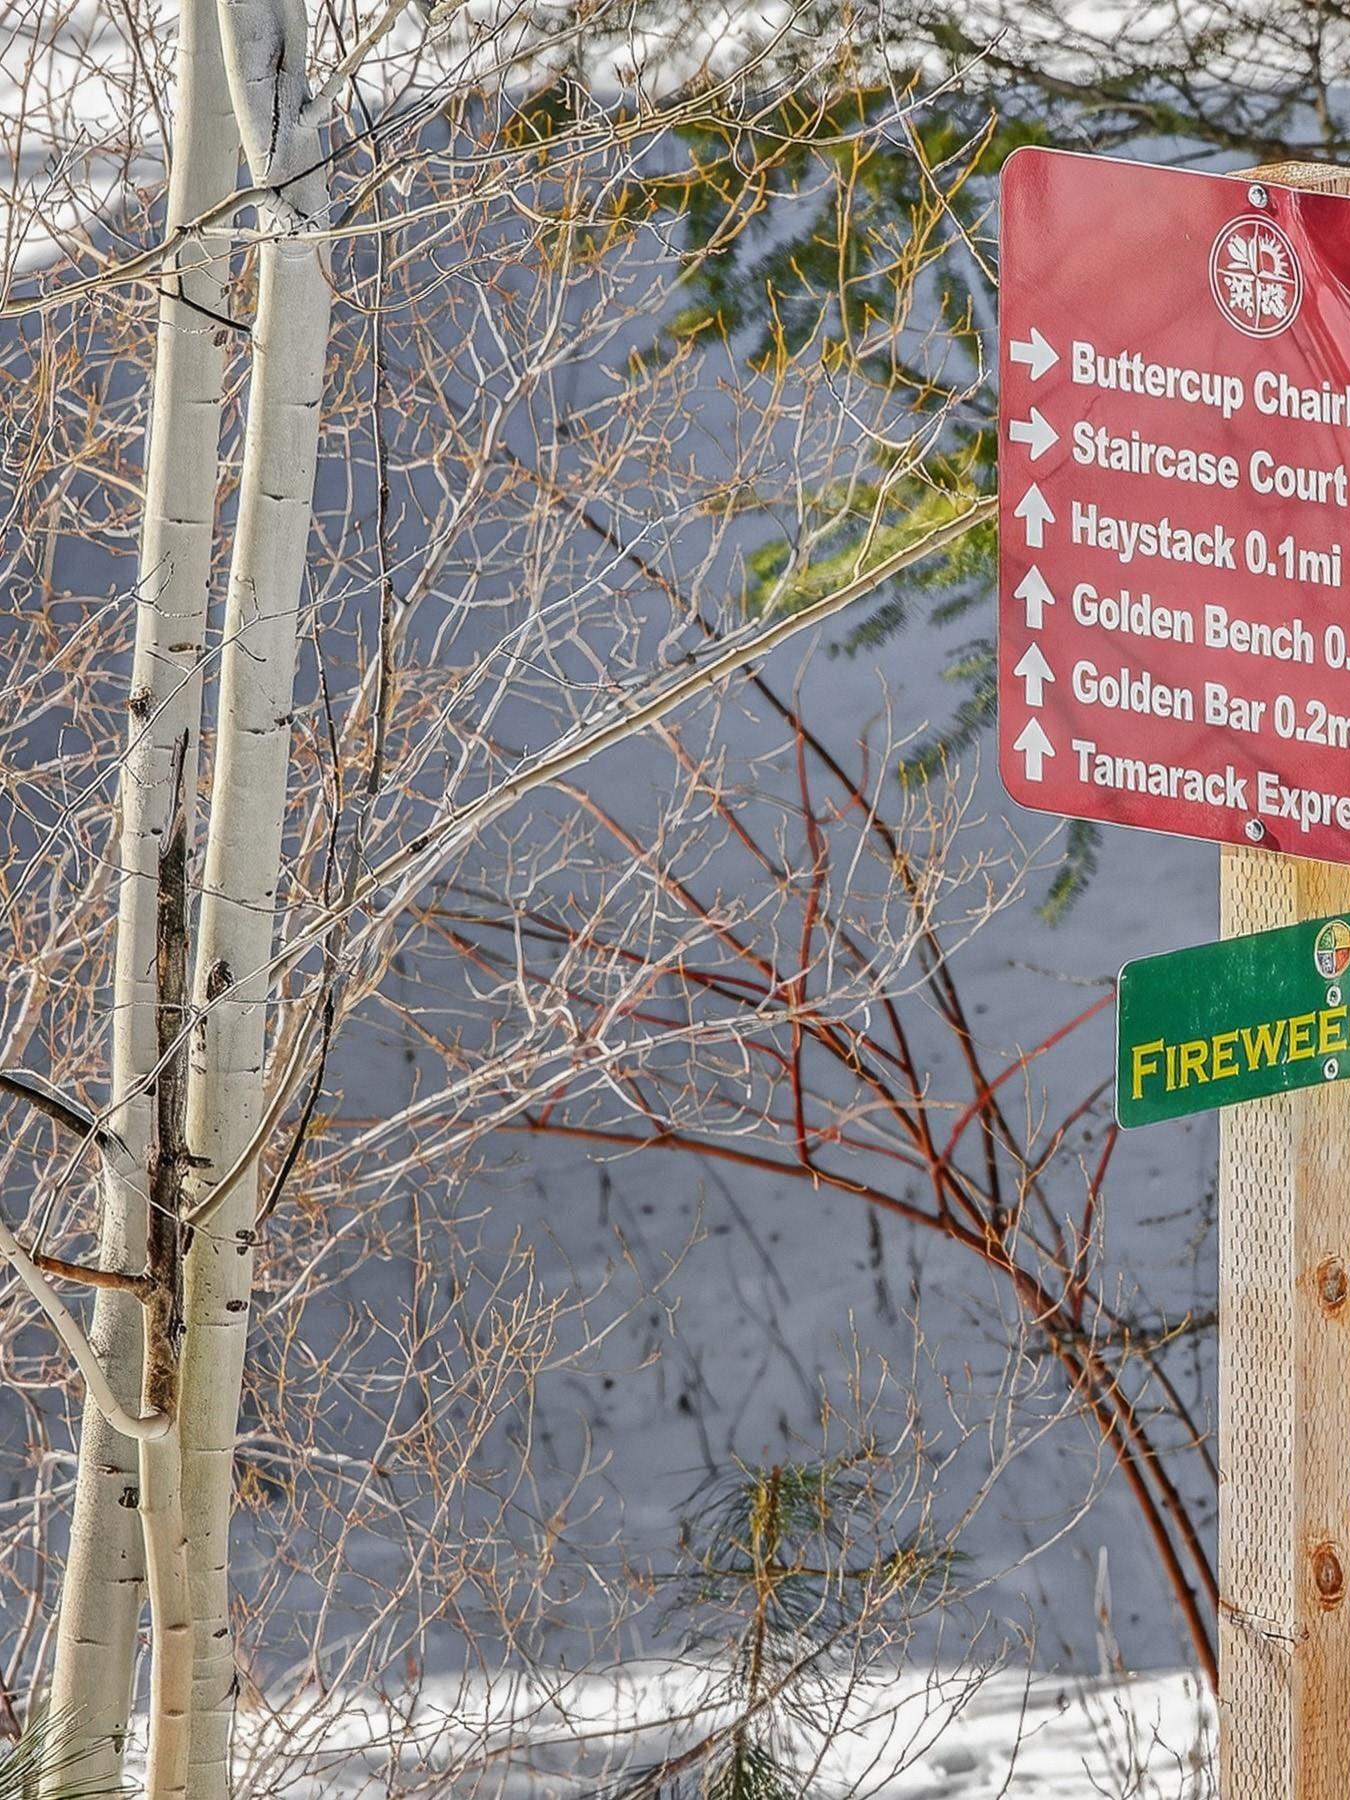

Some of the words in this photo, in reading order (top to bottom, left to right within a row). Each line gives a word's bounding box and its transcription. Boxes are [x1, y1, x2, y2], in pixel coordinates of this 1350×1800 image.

[1071, 340, 1244, 419] Buttercup
[1072, 420, 1239, 489] Staircase
[1249, 451, 1347, 507] Court
[1071, 501, 1236, 569] Haystack
[1245, 530, 1342, 587] 0.1mi
[1072, 583, 1194, 644] Golden
[1205, 604, 1314, 664] Bench
[1072, 660, 1194, 721] Golden
[1205, 681, 1266, 734] Bar
[1071, 738, 1248, 811] Tamarack
